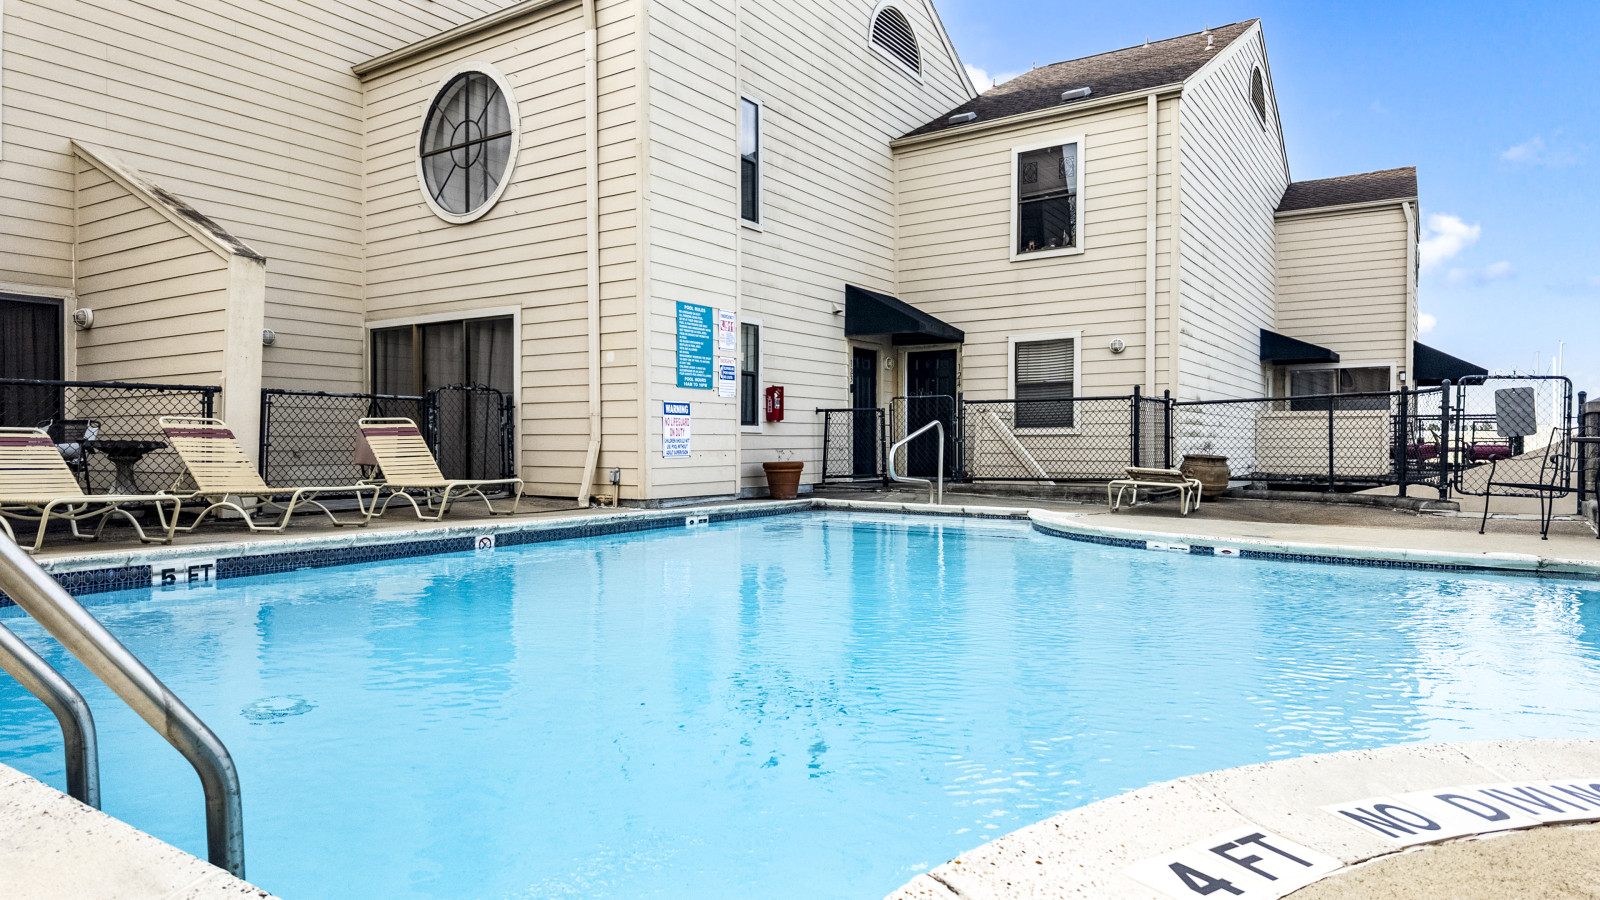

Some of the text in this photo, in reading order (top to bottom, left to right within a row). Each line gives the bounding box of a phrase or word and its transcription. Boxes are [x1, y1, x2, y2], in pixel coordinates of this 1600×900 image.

[665, 404, 689, 414] WARNING
[665, 417, 690, 427] NO LIFEGUARD
[670, 428, 685, 437] ON DUTY
[162, 564, 213, 586] 5 FT
[1338, 783, 1600, 839] NO DIVIN
[1168, 832, 1313, 896] 4 FT
